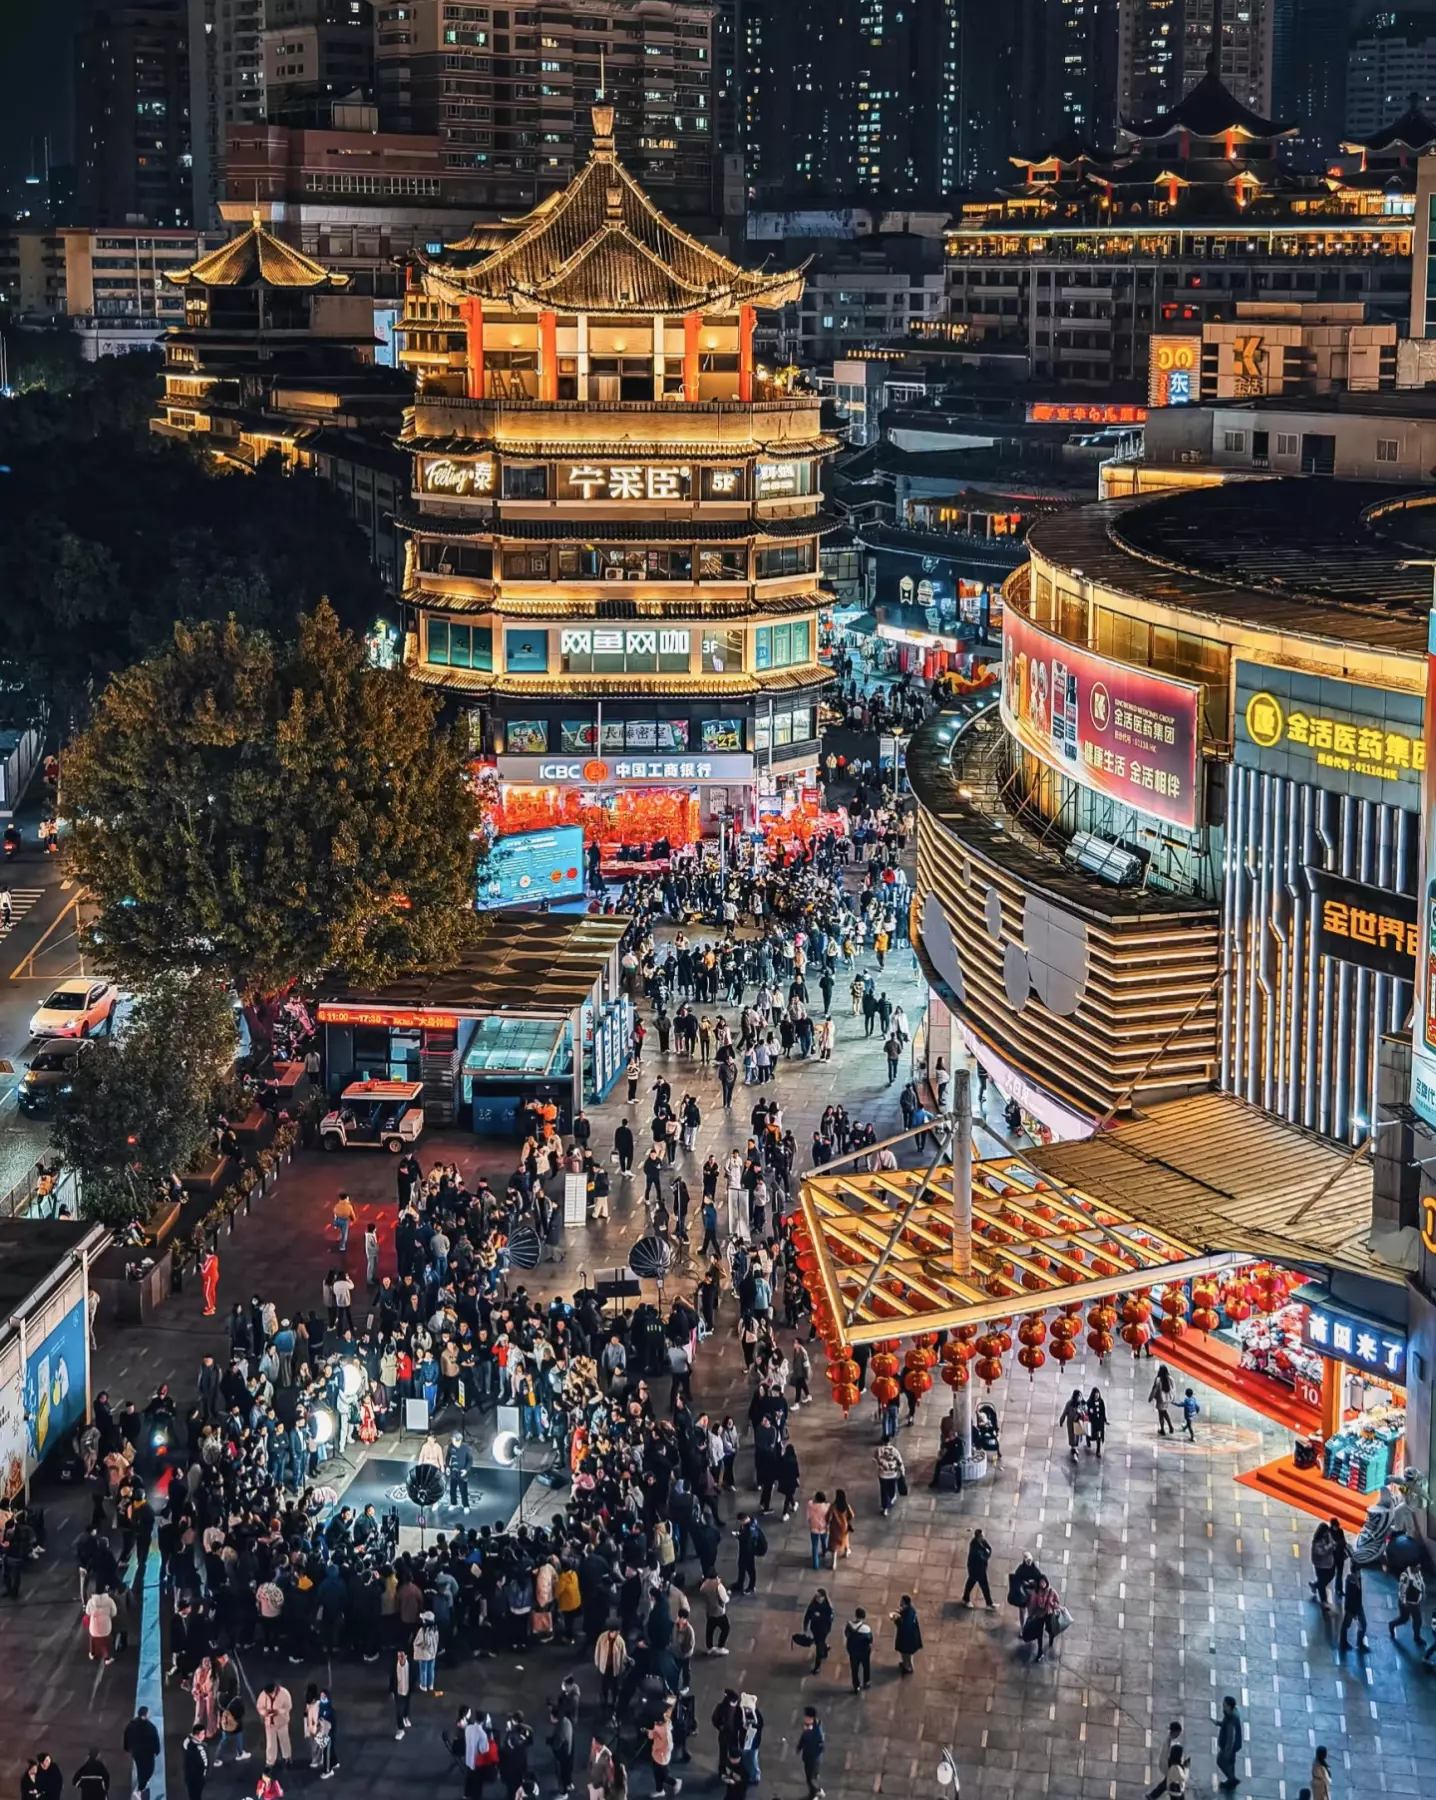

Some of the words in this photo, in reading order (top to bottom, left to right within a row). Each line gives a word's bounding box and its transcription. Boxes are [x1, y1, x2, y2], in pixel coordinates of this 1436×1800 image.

[569, 465, 681, 499] 宁采臣
[561, 629, 690, 654] 网鱼网咖
[702, 640, 718, 653] 3F
[1114, 708, 1175, 744] 金活医药集团
[540, 765, 580, 779] ICBC
[616, 762, 711, 779] 中国工商银行
[1084, 740, 1126, 777] 健康生活
[1130, 760, 1180, 799] 金活相伴
[1308, 1313, 1403, 1373] 莆田来了
